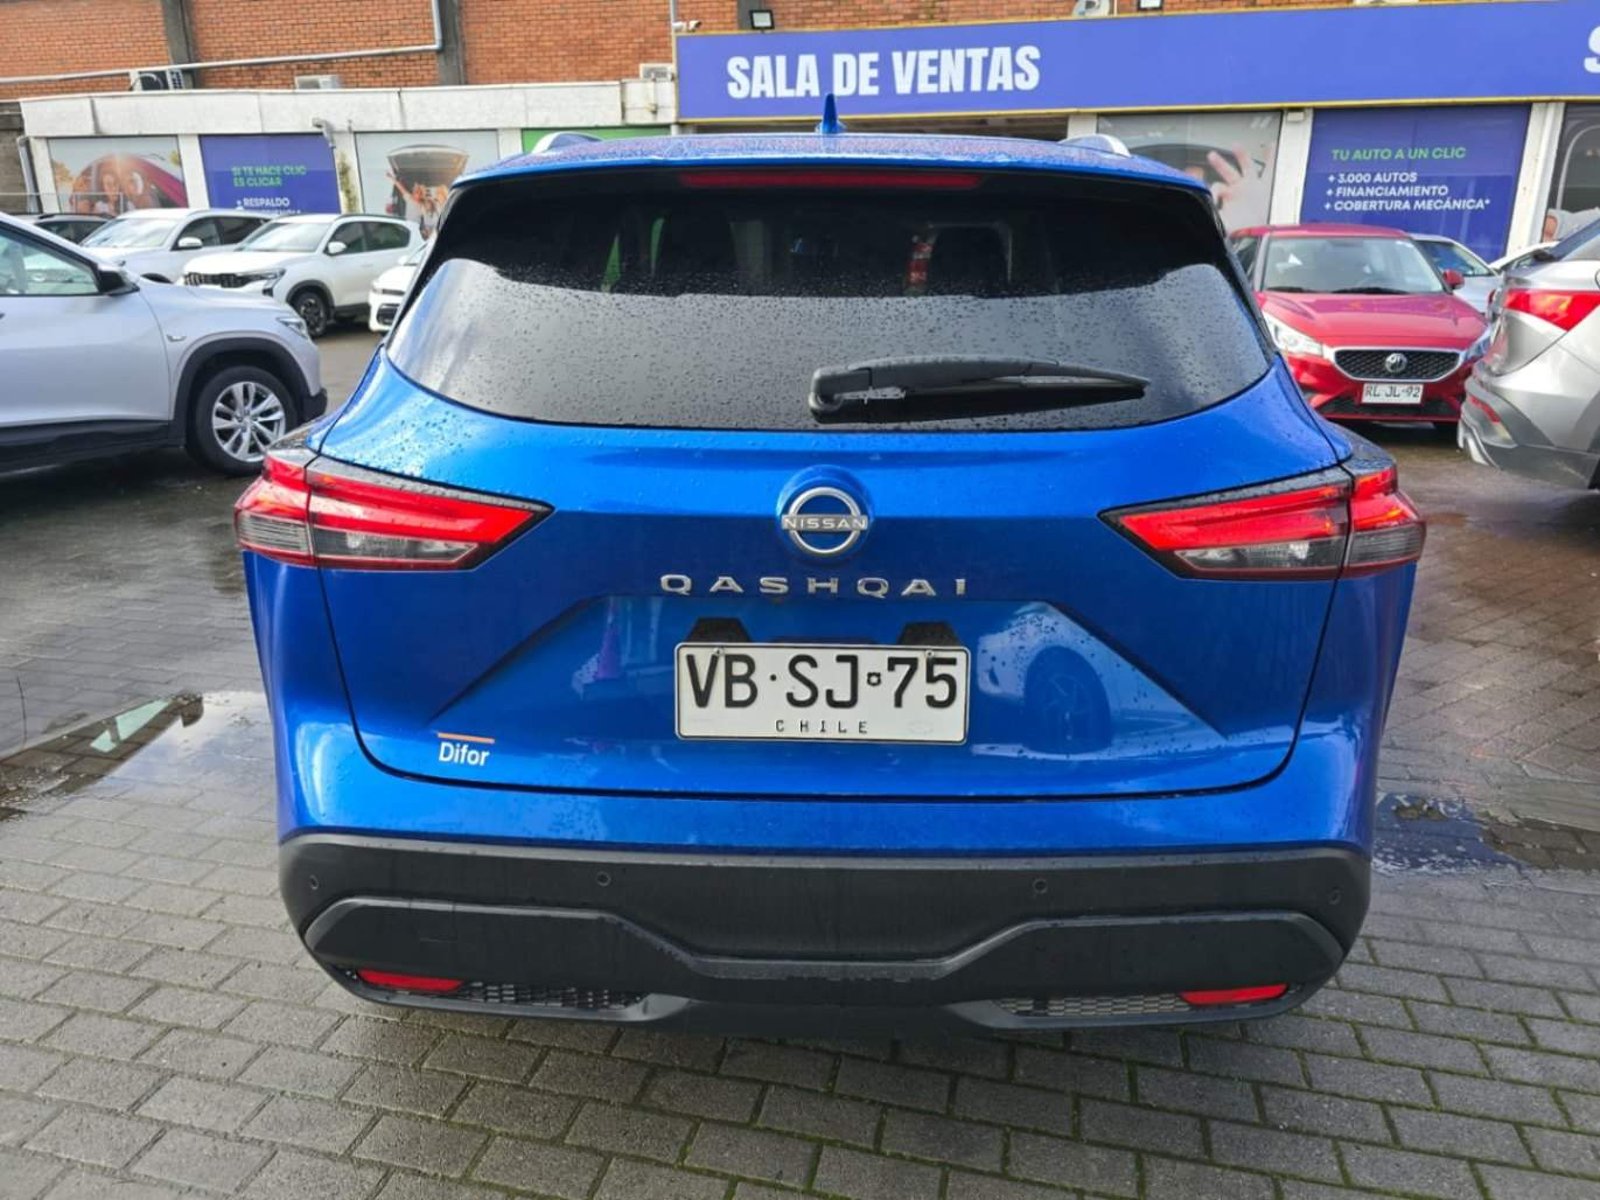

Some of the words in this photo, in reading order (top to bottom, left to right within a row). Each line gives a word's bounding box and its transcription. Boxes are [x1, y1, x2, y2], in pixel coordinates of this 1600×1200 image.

[726, 53, 820, 100] SALA
[832, 52, 880, 97] DE
[892, 45, 1041, 94] VENTAS
[1332, 149, 1350, 161] TU
[1352, 148, 1392, 160] AUTO
[1394, 149, 1405, 160] A
[1407, 148, 1429, 160] UN
[1432, 146, 1467, 159] CLIC
[1337, 173, 1371, 184] 3.000
[1372, 172, 1418, 183] AUTOS
[1335, 185, 1449, 197] FINANCIAMIENTO
[243, 197, 290, 207] RESPALDO
[1333, 200, 1411, 211] COBERTURA
[783, 517, 867, 530] NISSAN
[660, 574, 967, 599] QASHQAI
[775, 719, 868, 734] CHILE
[439, 741, 490, 766] Difor
